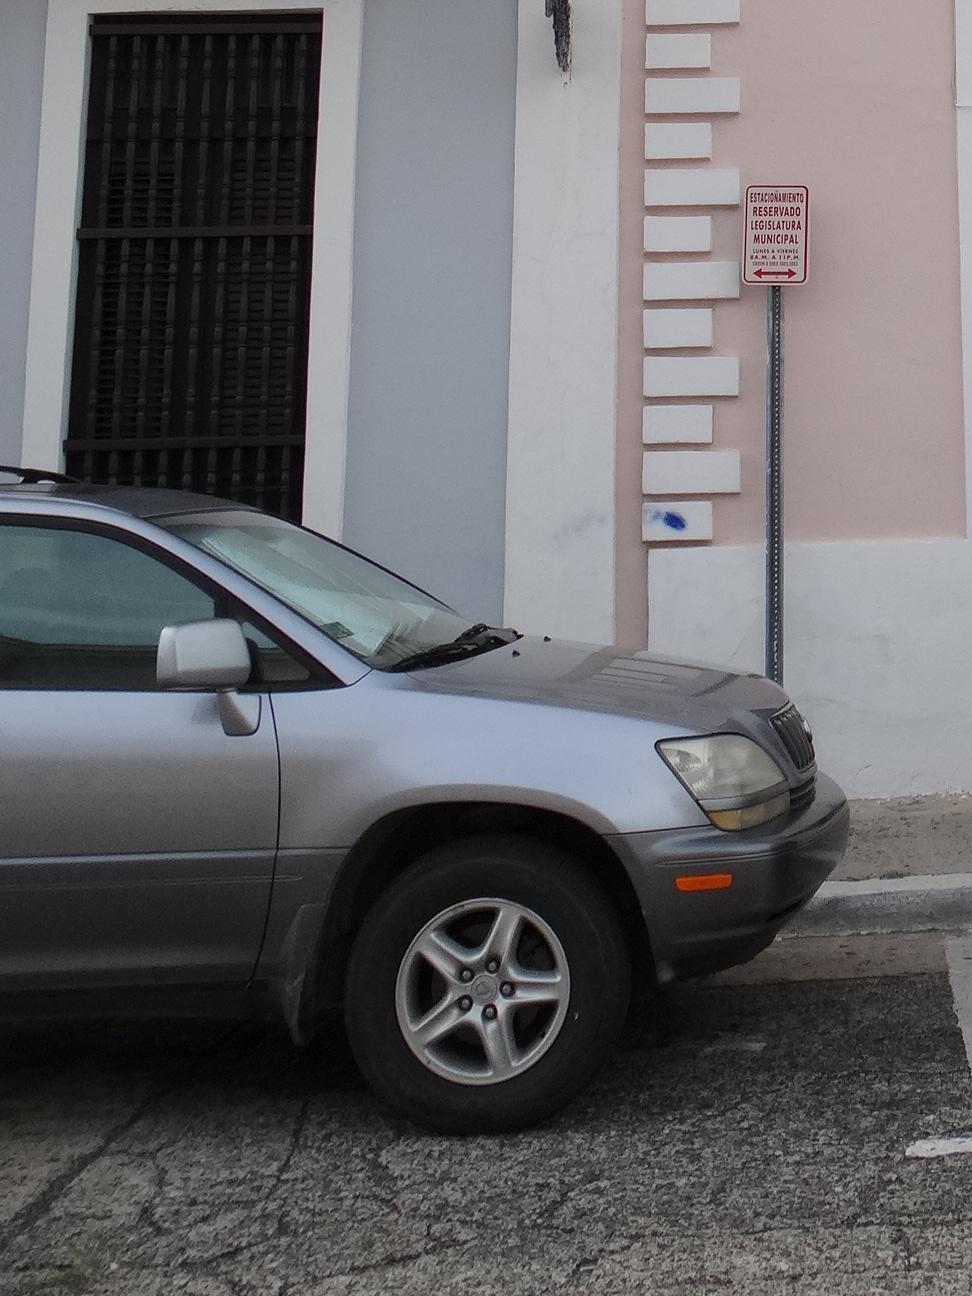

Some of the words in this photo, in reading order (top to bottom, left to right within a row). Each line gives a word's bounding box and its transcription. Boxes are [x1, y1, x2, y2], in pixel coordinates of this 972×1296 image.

[750, 193, 804, 203] ESTACIONAMIENTO
[752, 206, 801, 217] RESERVADO
[750, 220, 801, 231] LEGISLATURA
[753, 234, 799, 244] MUNICIPAL
